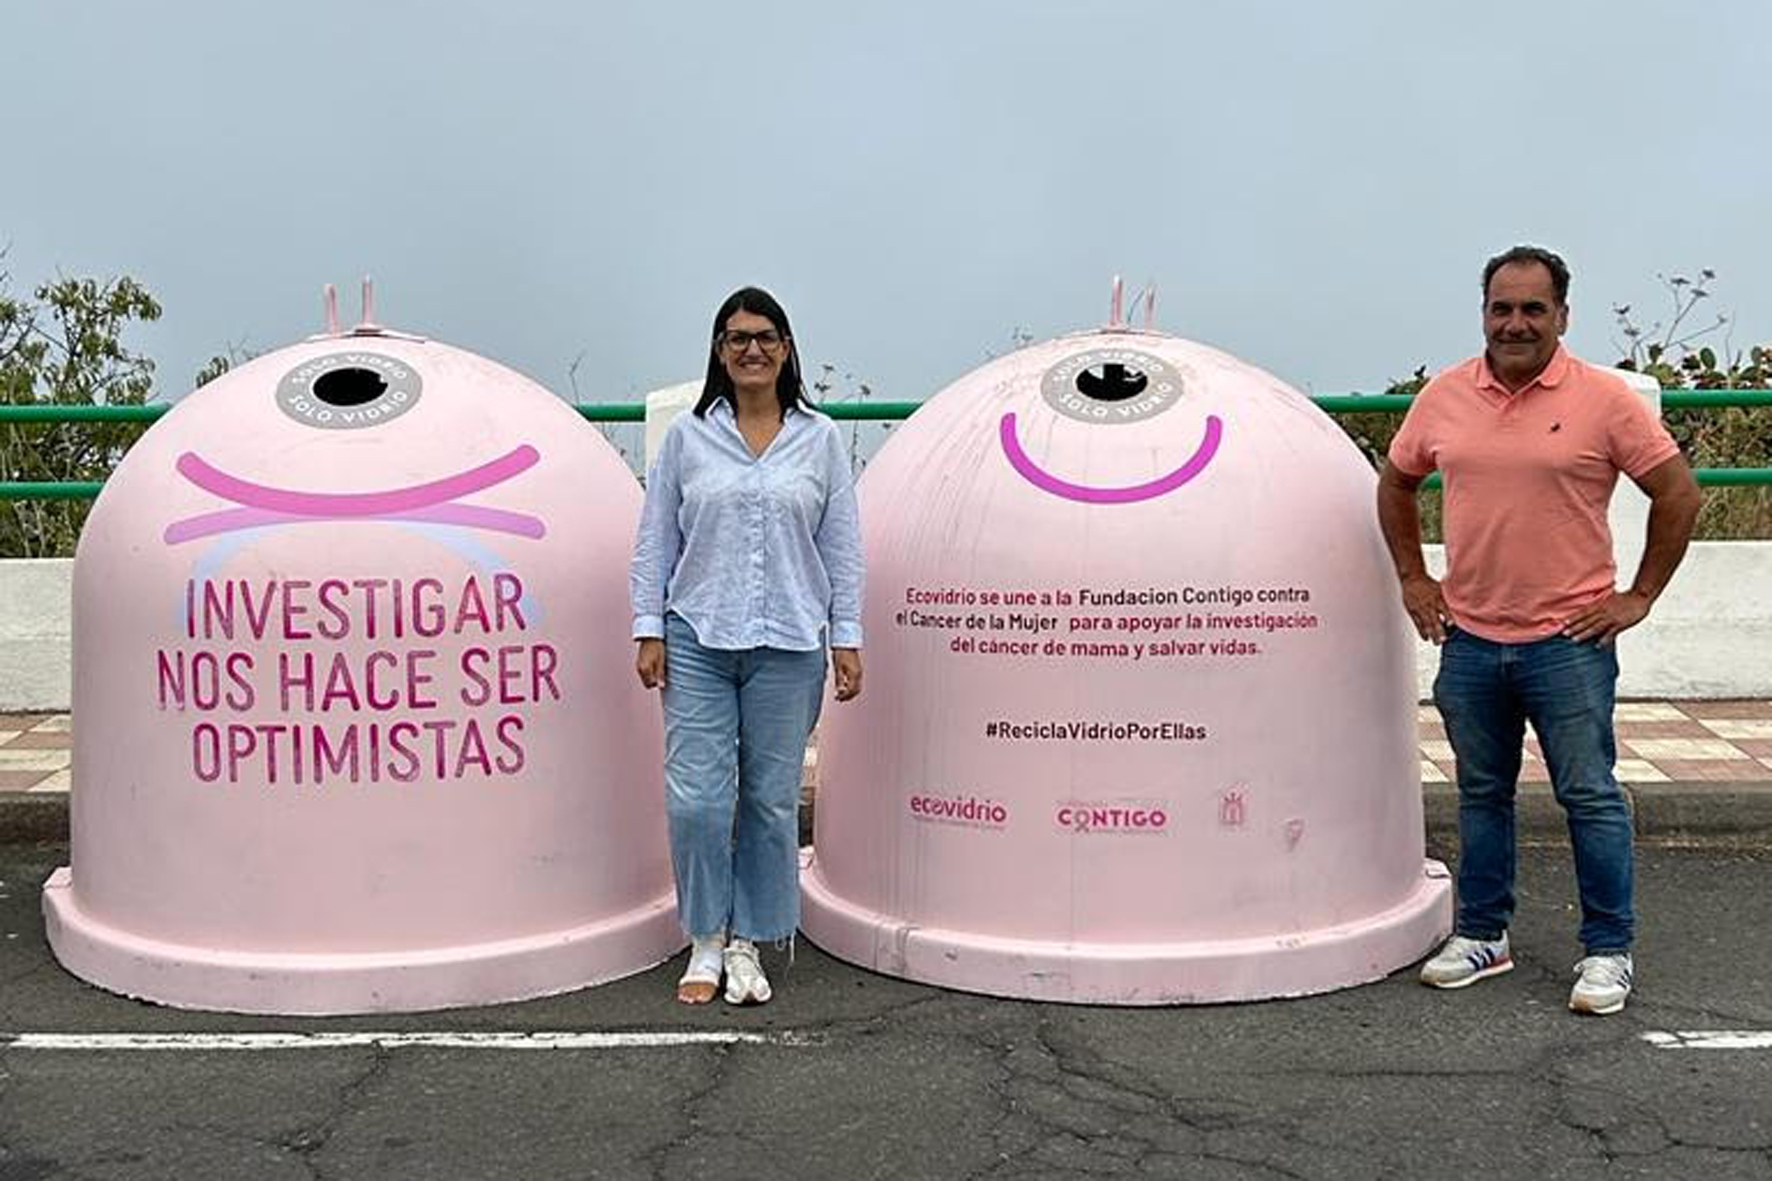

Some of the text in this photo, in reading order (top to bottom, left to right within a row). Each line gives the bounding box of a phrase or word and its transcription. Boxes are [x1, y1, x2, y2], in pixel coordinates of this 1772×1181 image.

[289, 391, 408, 422] SOLO VIDRIO
[1059, 382, 1173, 417] SOLO VIDRIO
[187, 573, 526, 640] INVESTIGAR
[906, 586, 1310, 607] Ecovidrio se une a la Fundacion Contigo contra
[896, 611, 907, 625] el
[966, 613, 986, 630] de
[990, 614, 1004, 630] la
[1009, 613, 1058, 633] Mujer
[1069, 616, 1112, 632] para
[1117, 616, 1182, 633] apoyar
[1187, 613, 1202, 629] la
[1207, 611, 1318, 632] investigación
[950, 636, 1263, 660] del cáncer de mama y salvar vidas.
[158, 644, 560, 712] NOS HACE SER
[986, 722, 1207, 740] #ReciclaVidrioPorEllas
[192, 716, 525, 785] OPTIMISTAS
[910, 795, 1007, 822] ecovidrio
[1058, 808, 1167, 833] CONTIGO
